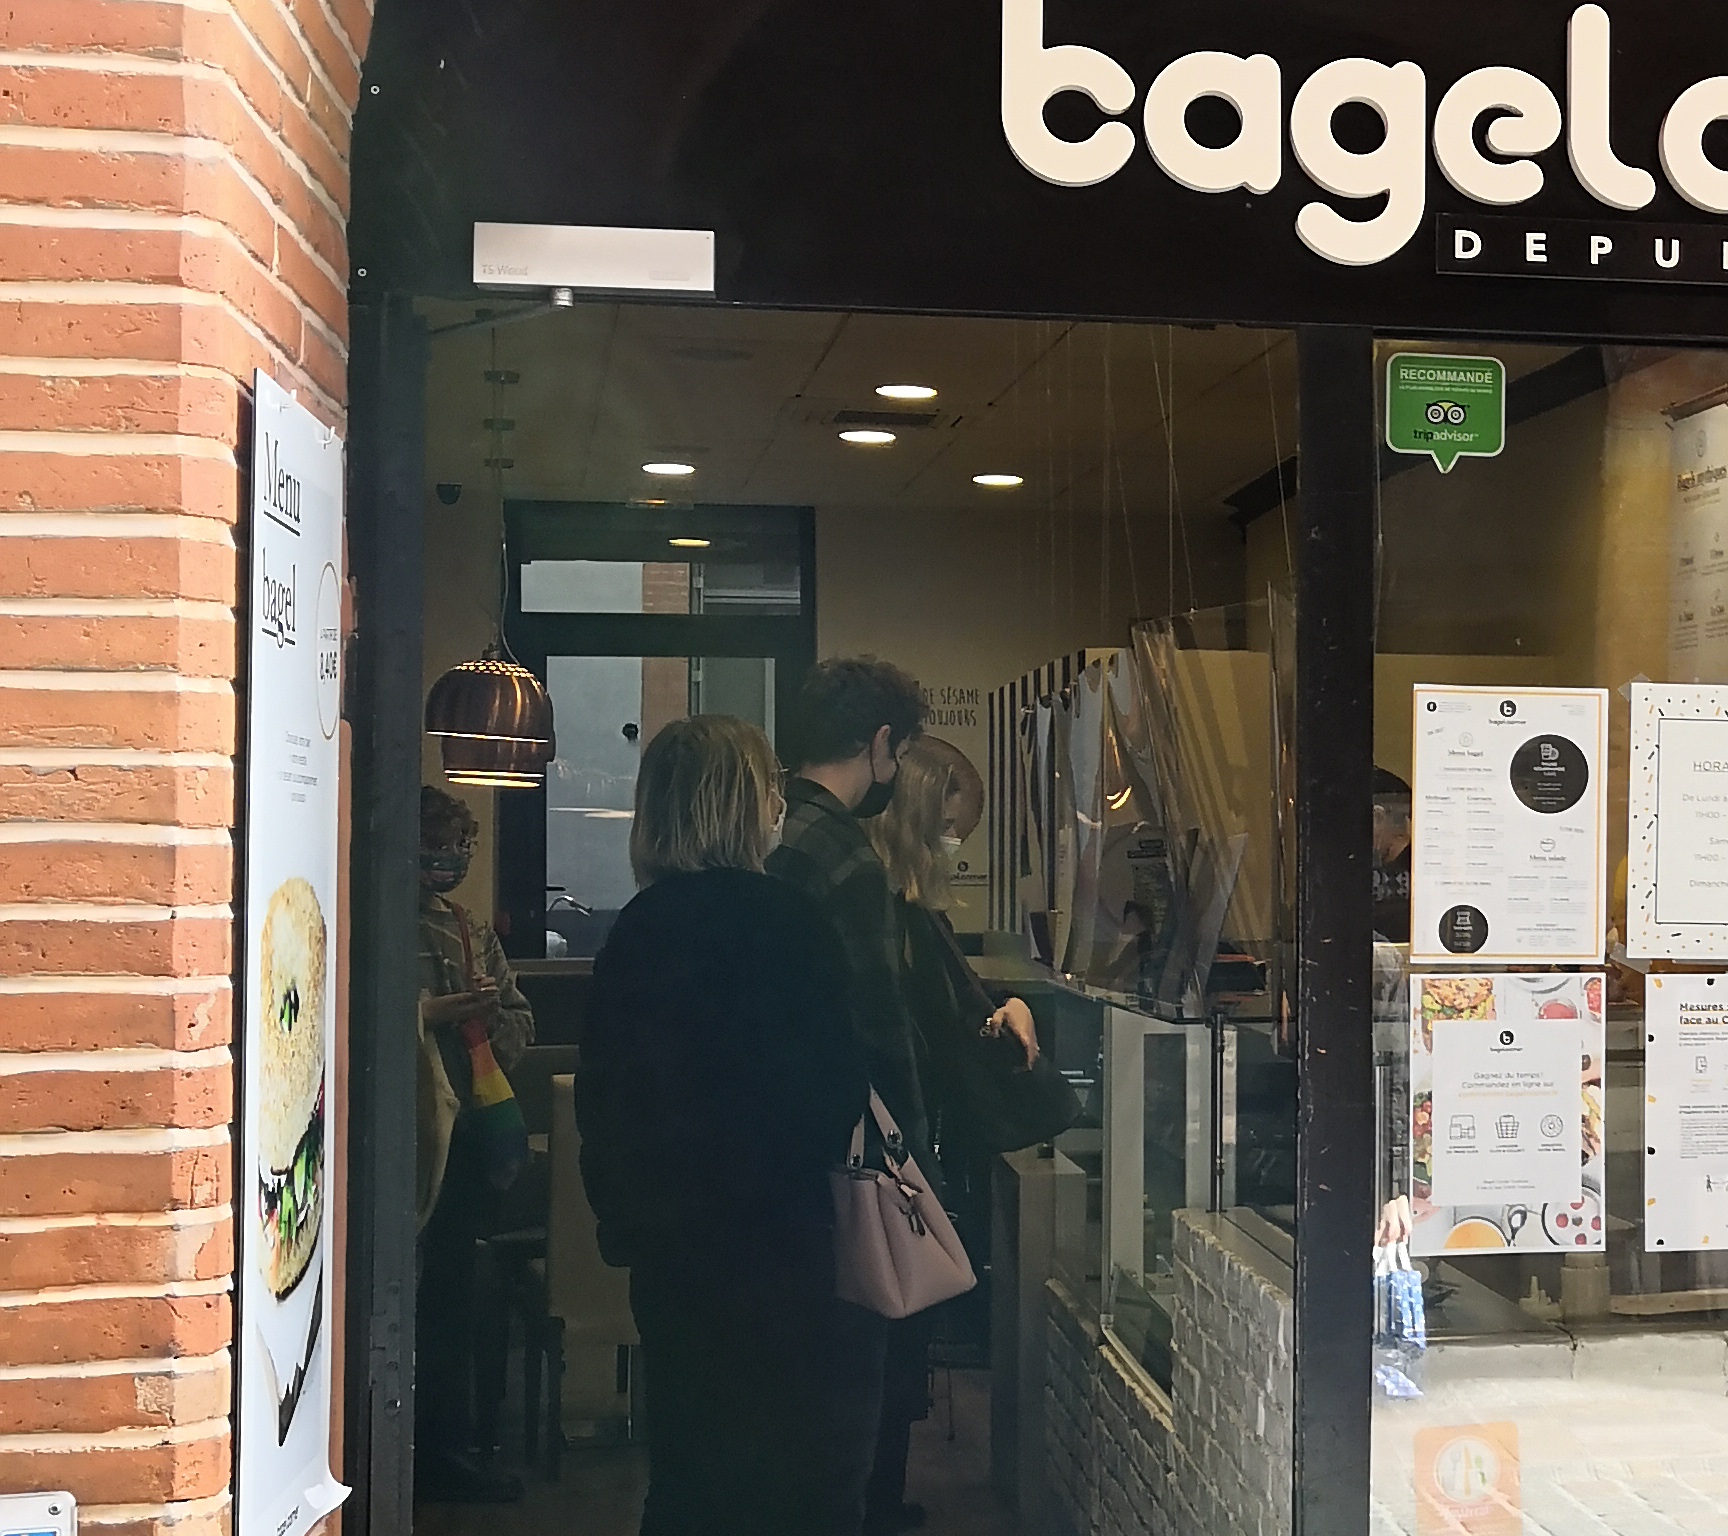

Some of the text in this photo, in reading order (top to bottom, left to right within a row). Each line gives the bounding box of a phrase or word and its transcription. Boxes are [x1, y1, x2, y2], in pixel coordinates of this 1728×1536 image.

[1413, 429, 1475, 442] tripadvisor
[263, 431, 302, 524] Menu
[261, 547, 297, 649] bagel
[941, 686, 979, 705] SÉSAME
[1679, 1002, 1724, 1012] Mesures
[1679, 1015, 1702, 1024] face
